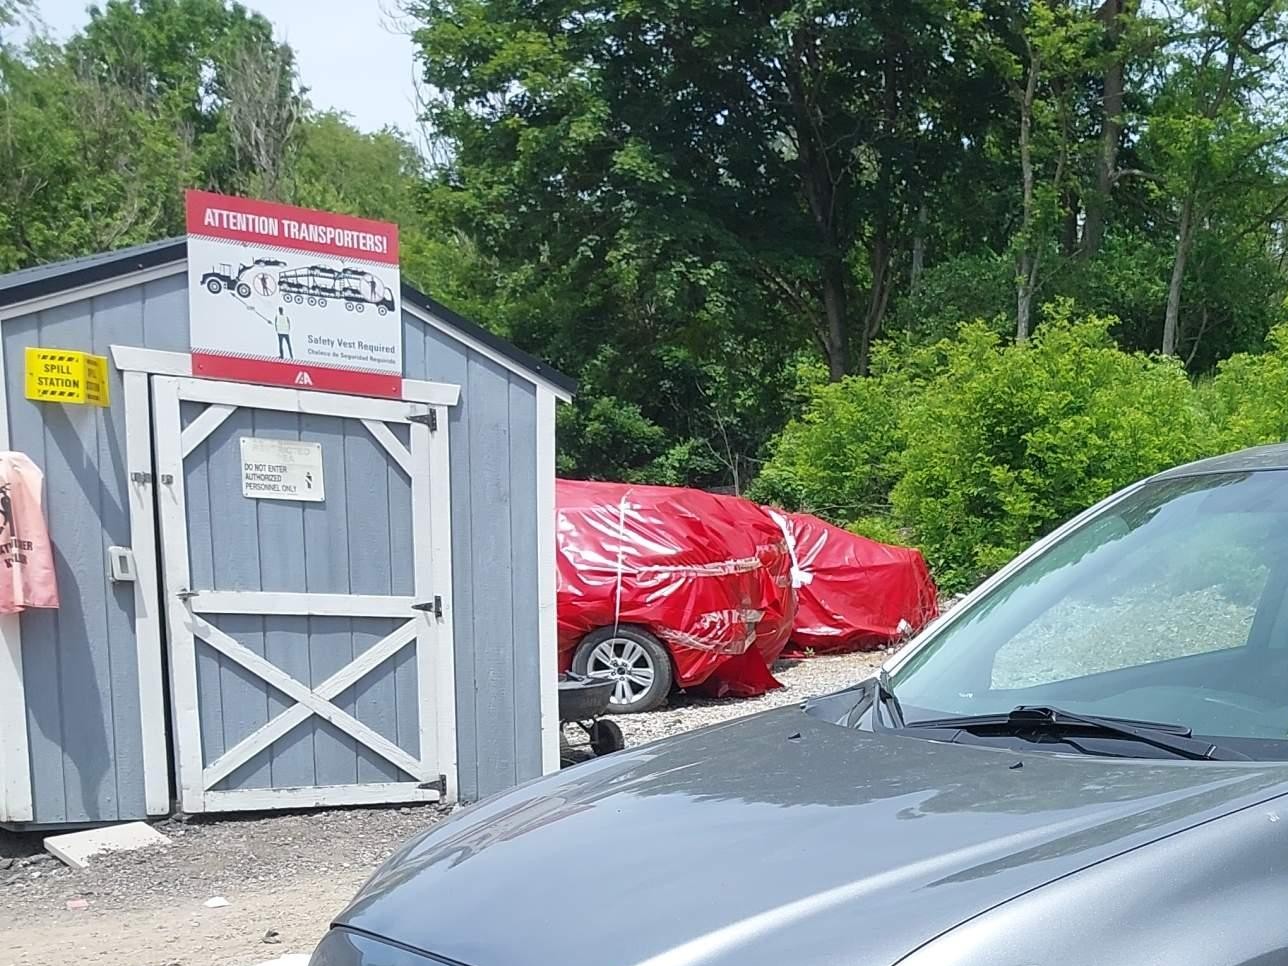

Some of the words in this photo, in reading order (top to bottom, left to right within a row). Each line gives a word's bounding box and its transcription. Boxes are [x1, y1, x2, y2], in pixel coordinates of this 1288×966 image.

[204, 208, 278, 237] ATTENTION
[281, 219, 387, 253] TRANSPORTERS!
[307, 334, 335, 348] Safety
[337, 338, 356, 348] Vest
[357, 340, 396, 354] Required
[44, 363, 72, 375] SPILL
[37, 376, 80, 389] STATION
[244, 463, 254, 471] DO
[254, 463, 267, 472] NOT
[267, 464, 288, 474] ENTER
[245, 473, 282, 482] AUTHORIZED
[245, 482, 281, 492] PERSONNEL
[281, 484, 297, 493] ONLY
